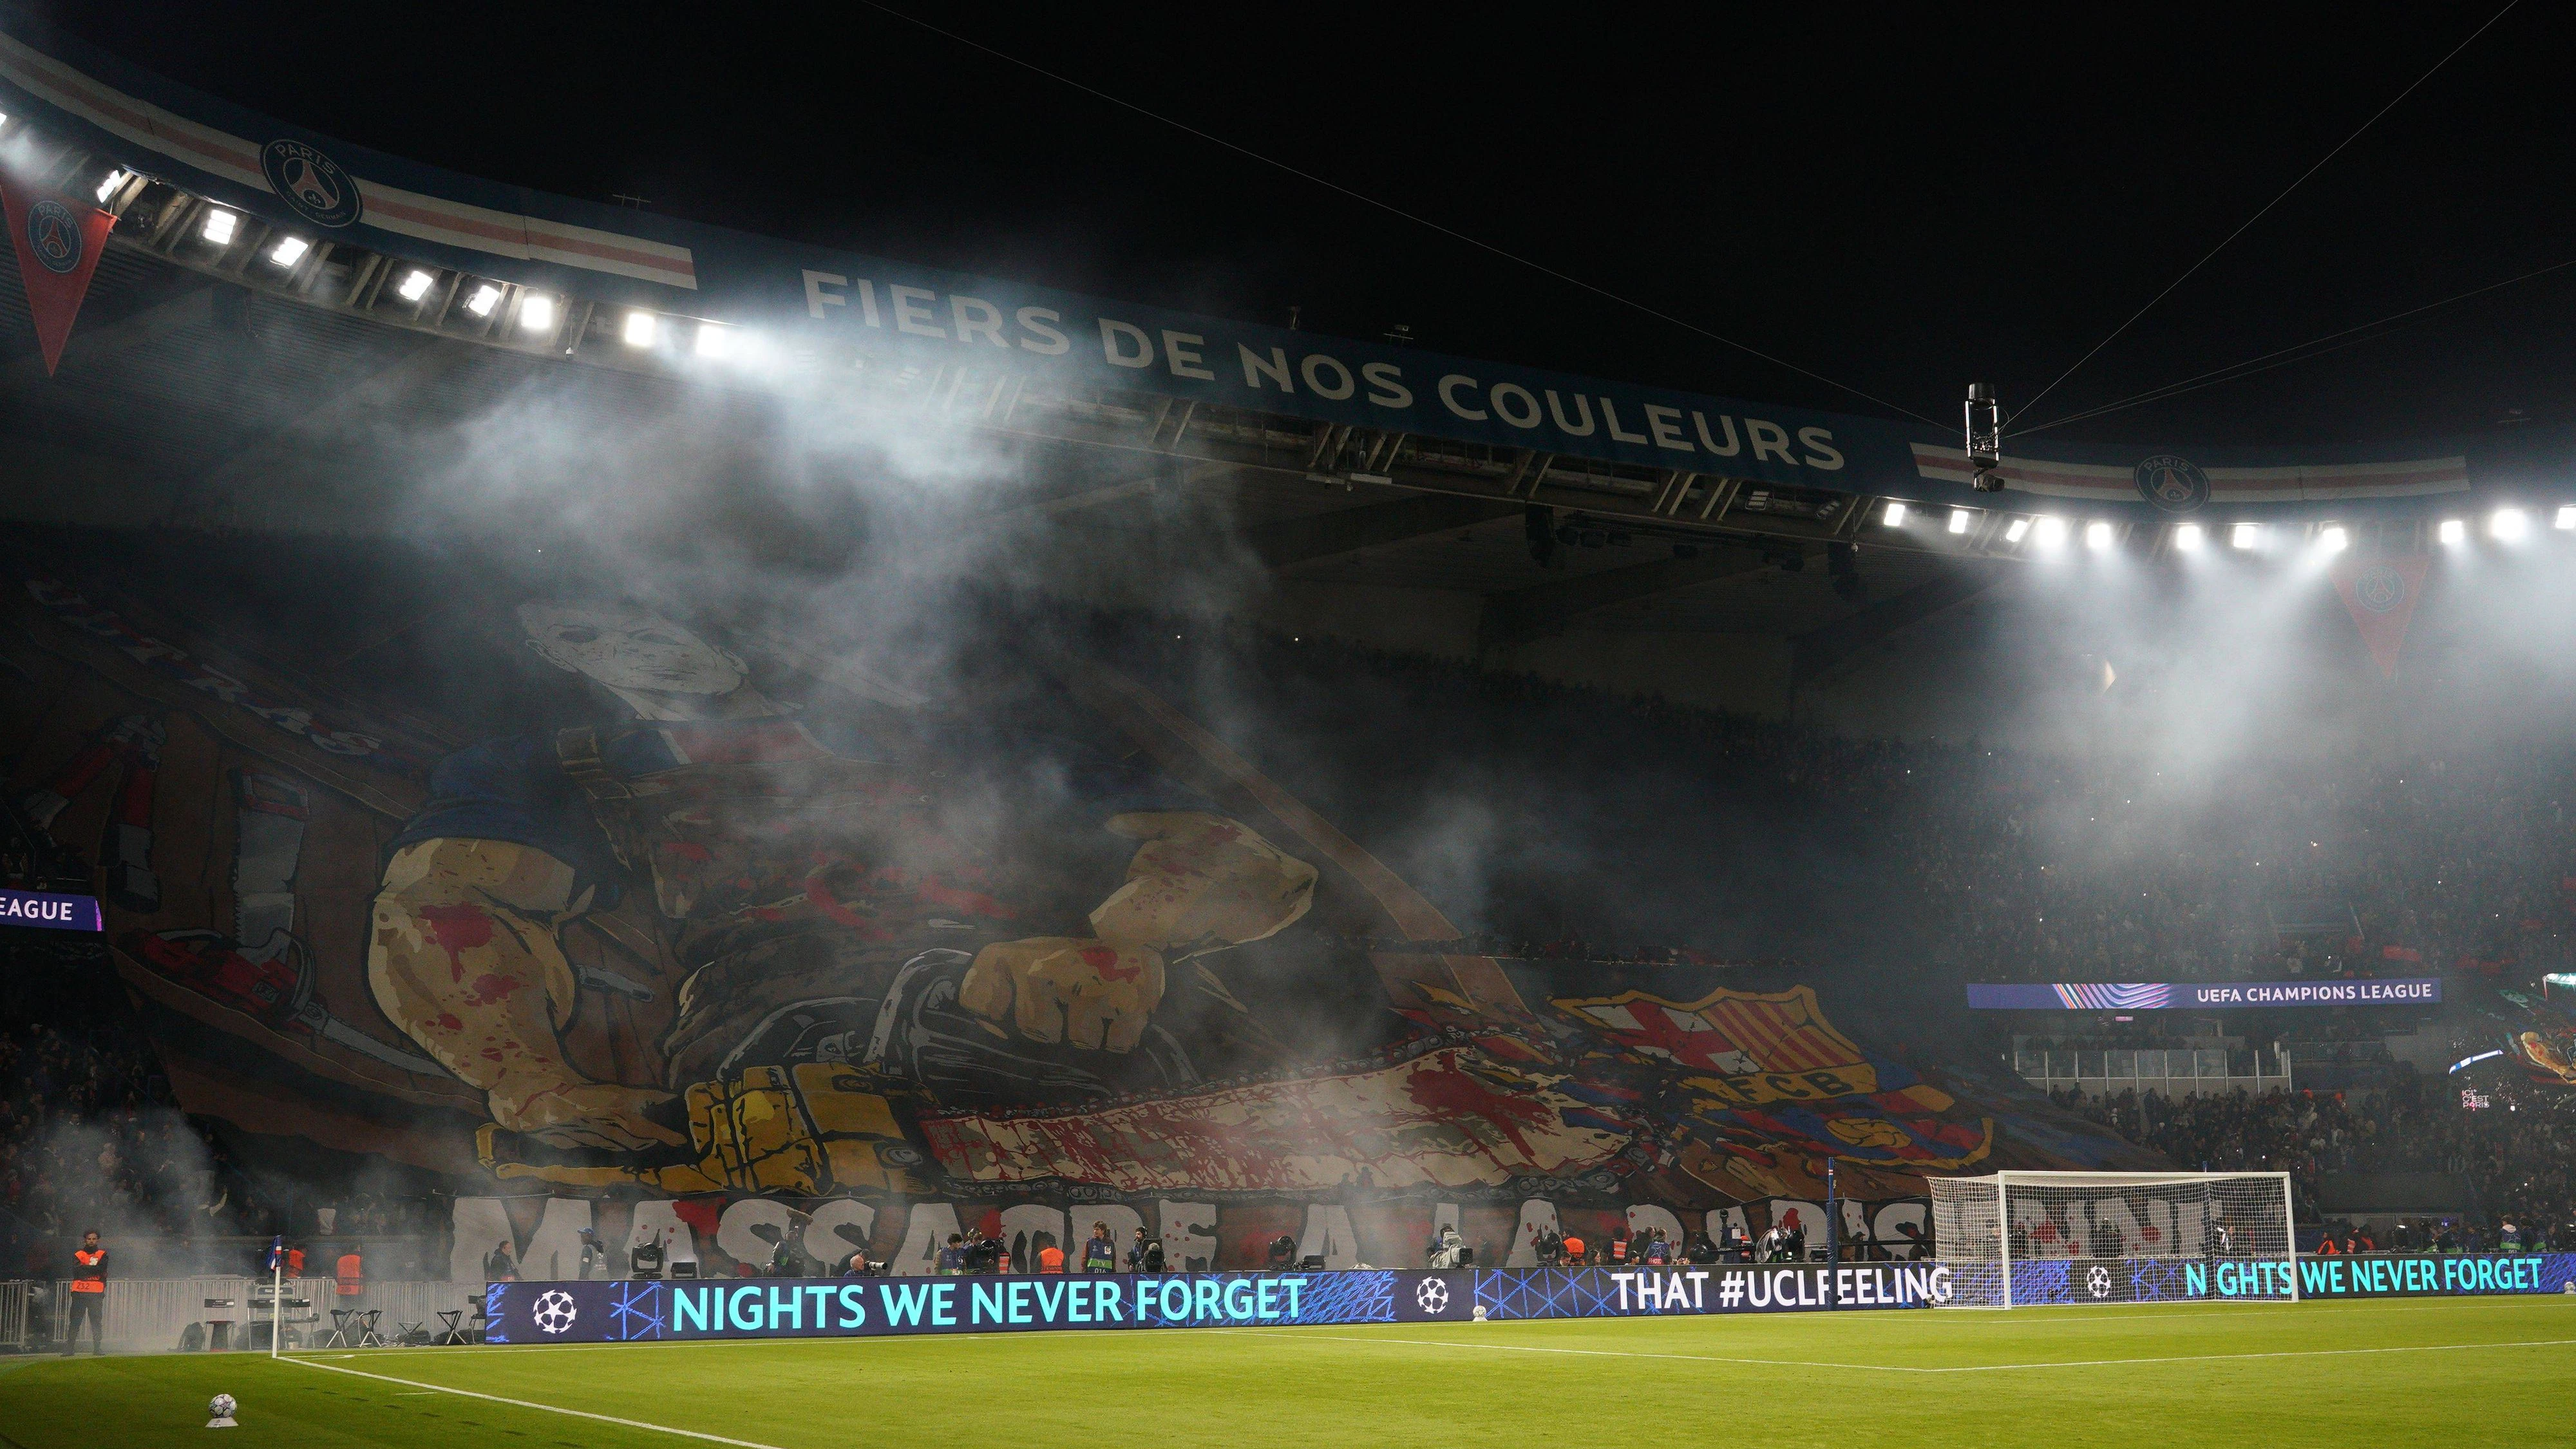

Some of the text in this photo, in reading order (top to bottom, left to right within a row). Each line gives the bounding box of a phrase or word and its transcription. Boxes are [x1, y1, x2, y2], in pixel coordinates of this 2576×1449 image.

[274, 144, 336, 175] PARIS
[38, 205, 73, 228] PARIS
[801, 269, 1845, 470] FIERS DE NOS COULEURS
[2144, 457, 2190, 472] PARIS
[2197, 983, 2432, 1002] UEFA CHAMPIONS LEAGUE
[1726, 1071, 1854, 1102] FCB
[1296, 1204, 1360, 1269] A
[1611, 1267, 1953, 1310] THAT #UCLFEELING
[2185, 1258, 2543, 1296] NGHTS WE NEVER FORGET
[674, 1278, 1307, 1331] NIGHTS WE NEVER FORGET
